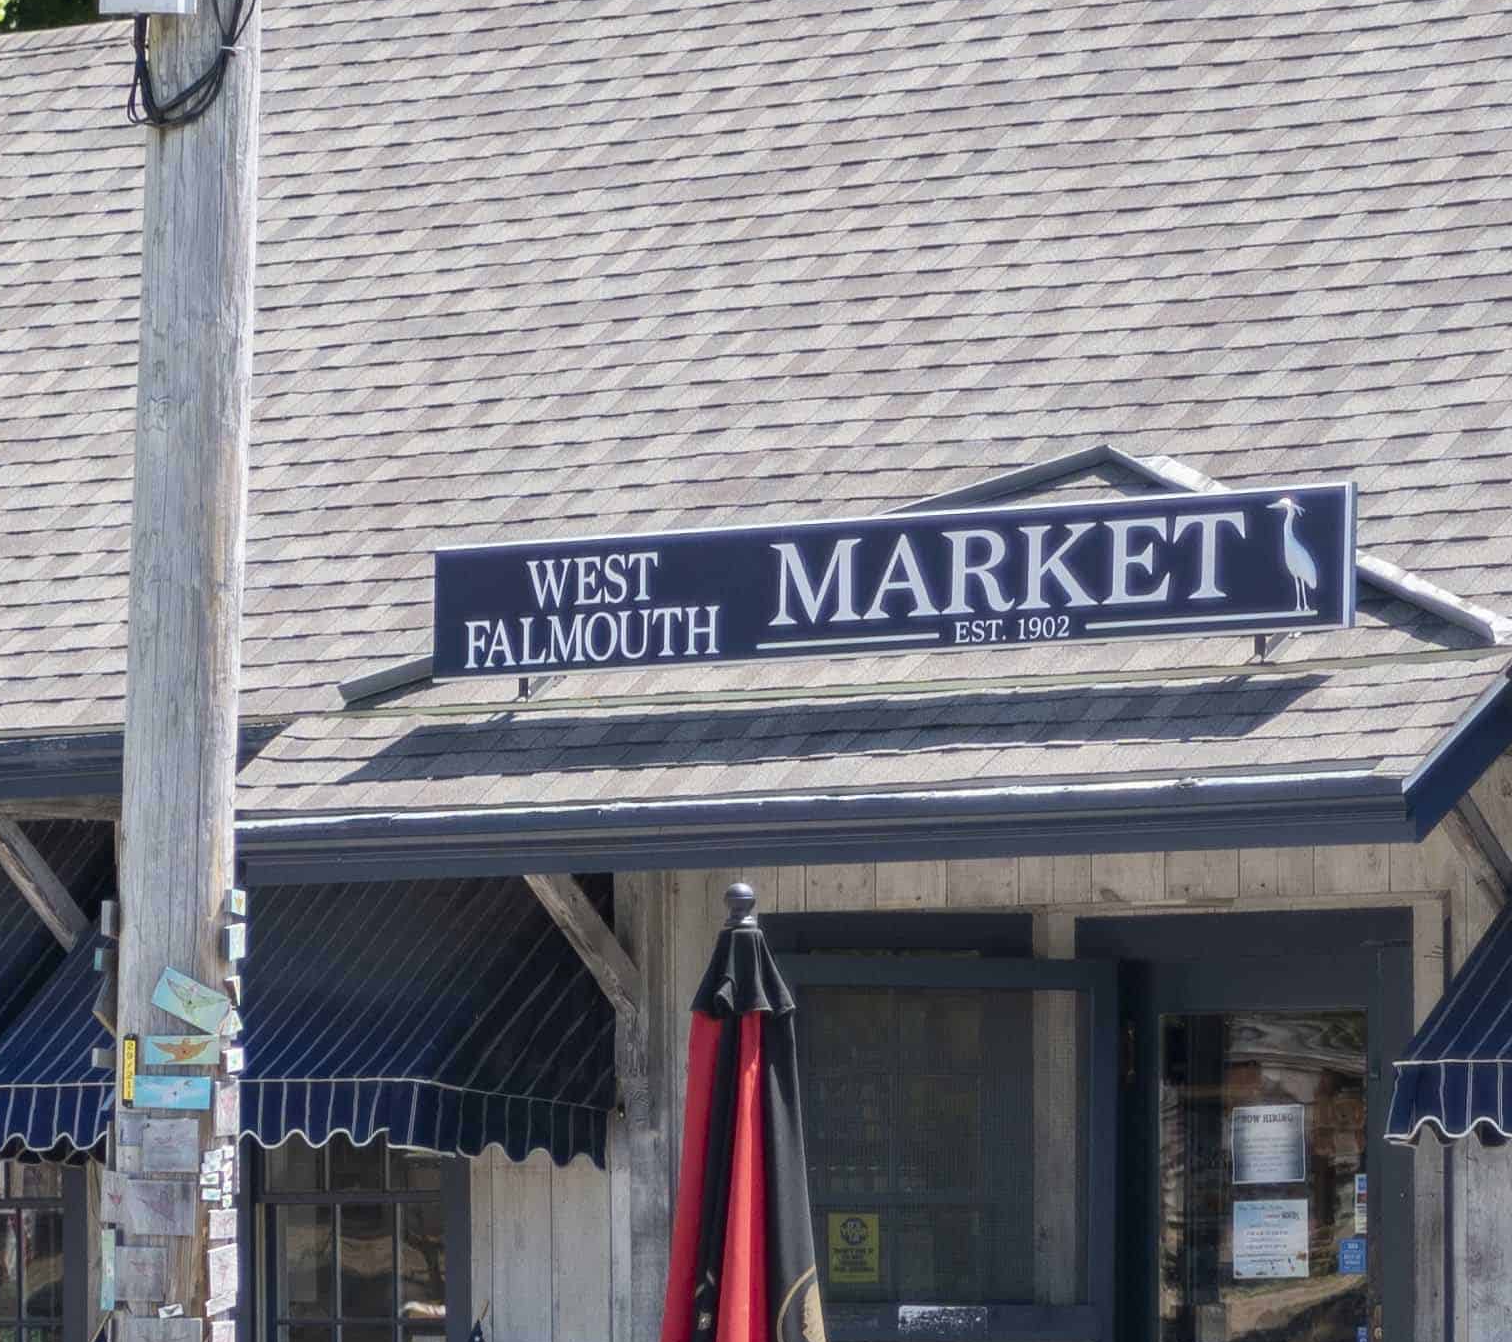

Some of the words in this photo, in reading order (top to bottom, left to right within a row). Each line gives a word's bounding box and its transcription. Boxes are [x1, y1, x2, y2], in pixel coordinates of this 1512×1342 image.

[527, 552, 658, 608] WEST
[769, 512, 1246, 626] MARKET
[464, 606, 721, 669] FALMOUTH
[953, 618, 1008, 644] EST.
[1017, 615, 1070, 641] 1902
